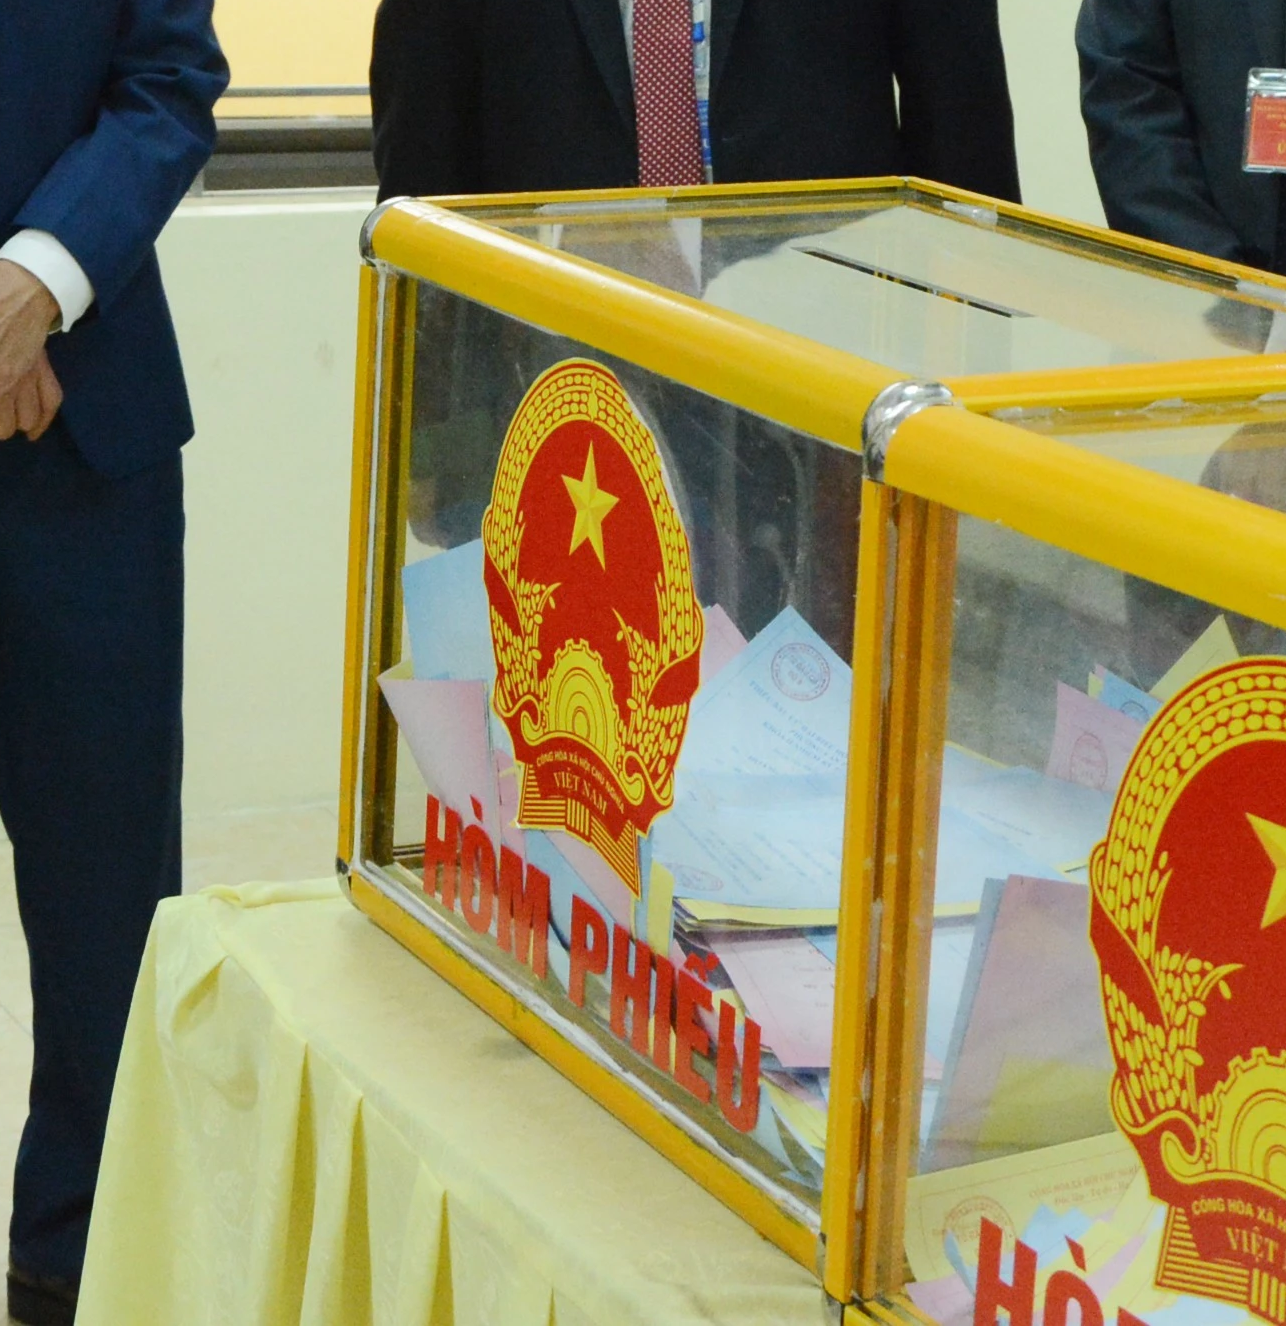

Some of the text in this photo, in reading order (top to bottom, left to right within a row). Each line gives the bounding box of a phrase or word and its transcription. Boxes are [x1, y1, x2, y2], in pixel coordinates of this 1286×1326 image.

[536, 751, 553, 767] CỘNG
[553, 749, 568, 762] HÒA
[569, 750, 579, 764] XÃ
[579, 757, 591, 772] HỘI
[591, 765, 606, 785] CHỦ
[553, 767, 608, 815] VIỆT NAM
[422, 793, 762, 1134] HÒM PHIẾU
[1191, 1195, 1225, 1215] CỘNG
[1227, 1197, 1254, 1218] HÒA
[1257, 1206, 1275, 1225] XÃ
[1226, 1225, 1279, 1263] VIỆT
[972, 1215, 1150, 1326] HÒ
